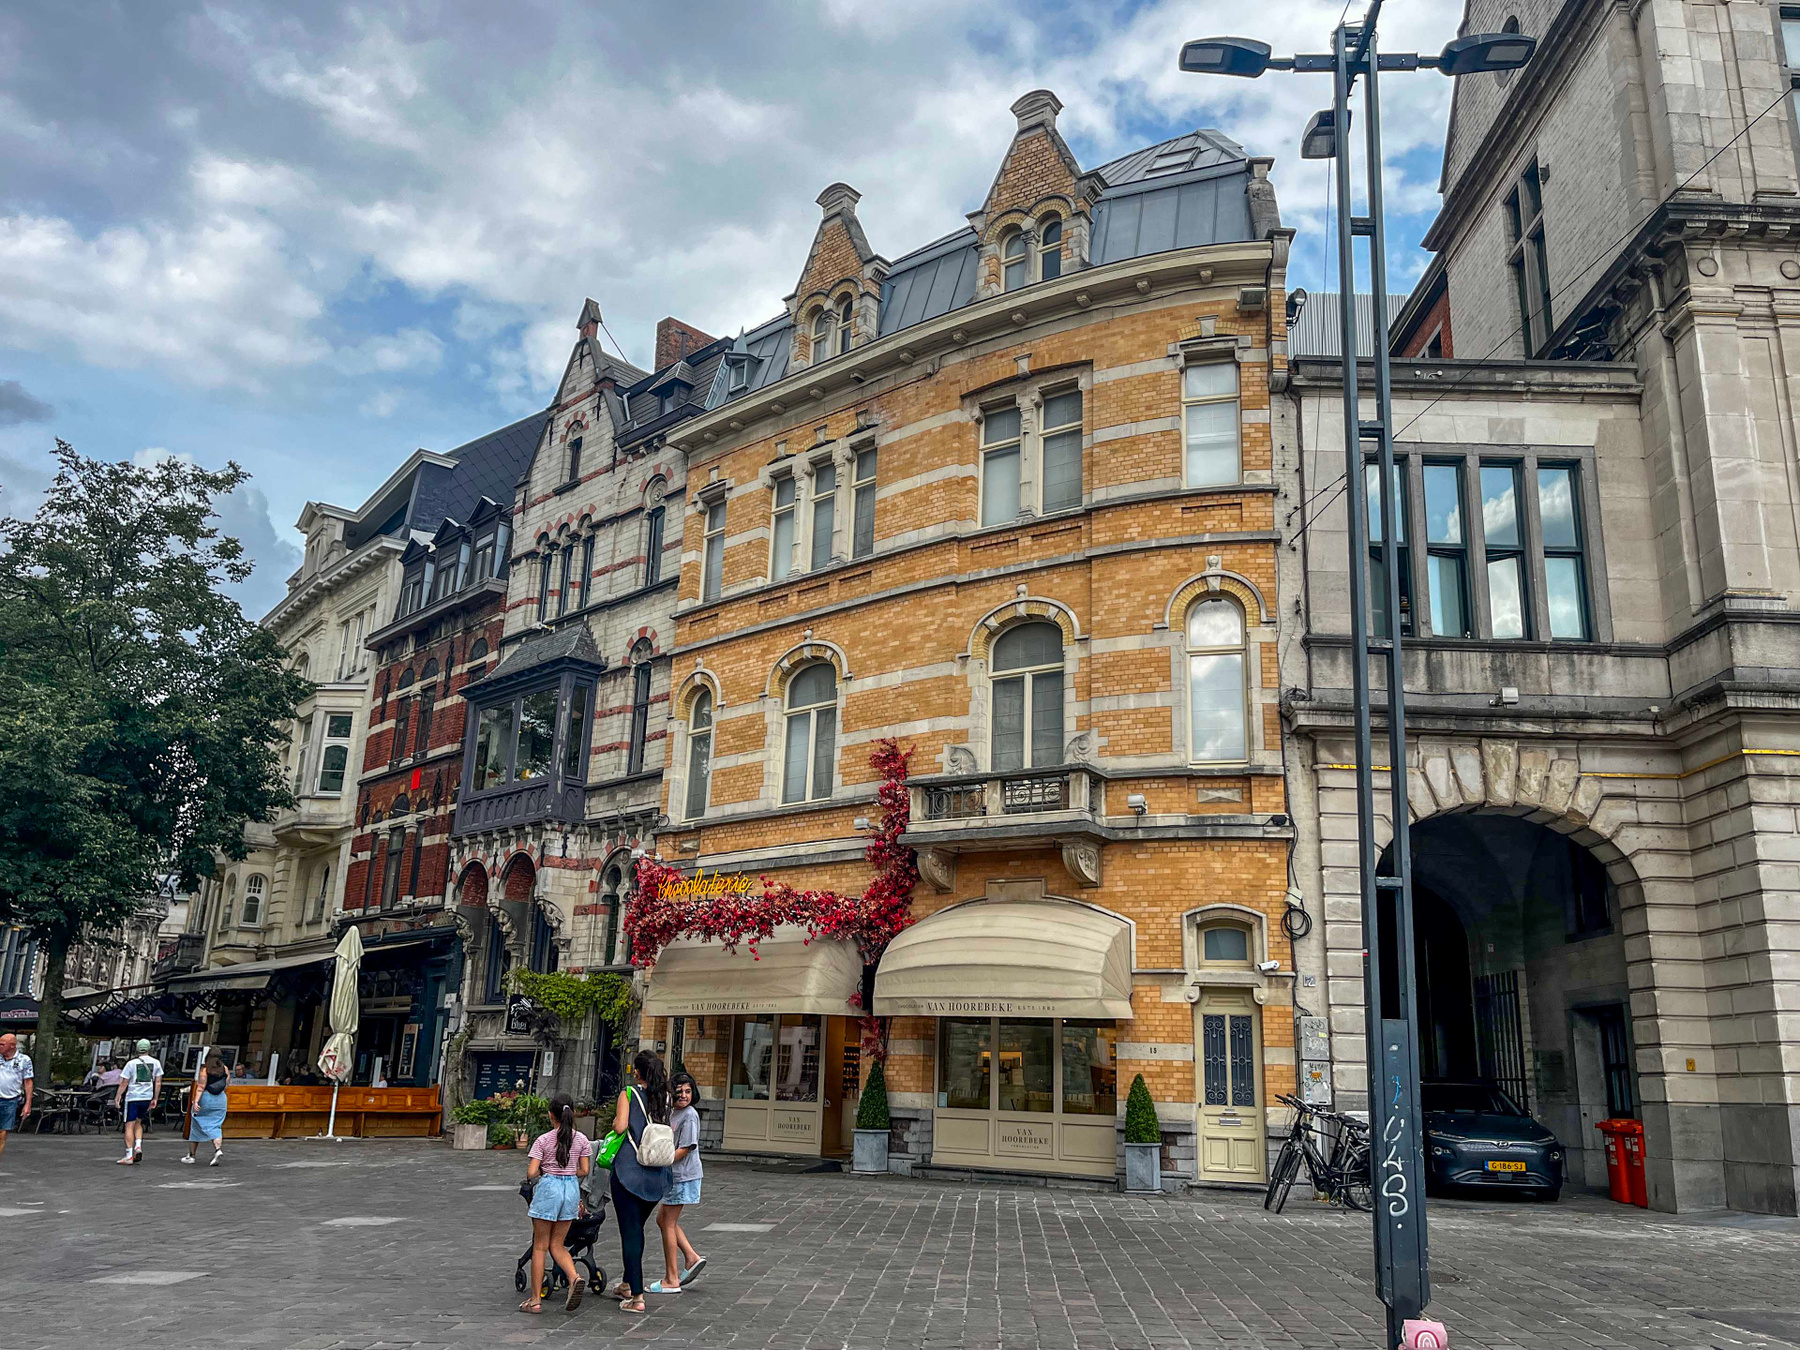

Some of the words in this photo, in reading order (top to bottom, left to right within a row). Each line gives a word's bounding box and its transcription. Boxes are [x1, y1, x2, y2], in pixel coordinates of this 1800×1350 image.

[658, 868, 753, 900] Chocolaterie
[691, 1002, 705, 1011] VAN
[706, 1002, 751, 1011] HOOREBEKE
[926, 1002, 945, 1011] VAN
[948, 1002, 1013, 1012] HOOREBEKE
[777, 1122, 812, 1130] HOOREBEKE
[1016, 1128, 1033, 1136] VAN
[1001, 1135, 1049, 1145] HOOREBEKE
[1491, 1162, 1523, 1170] G-186-SJ
